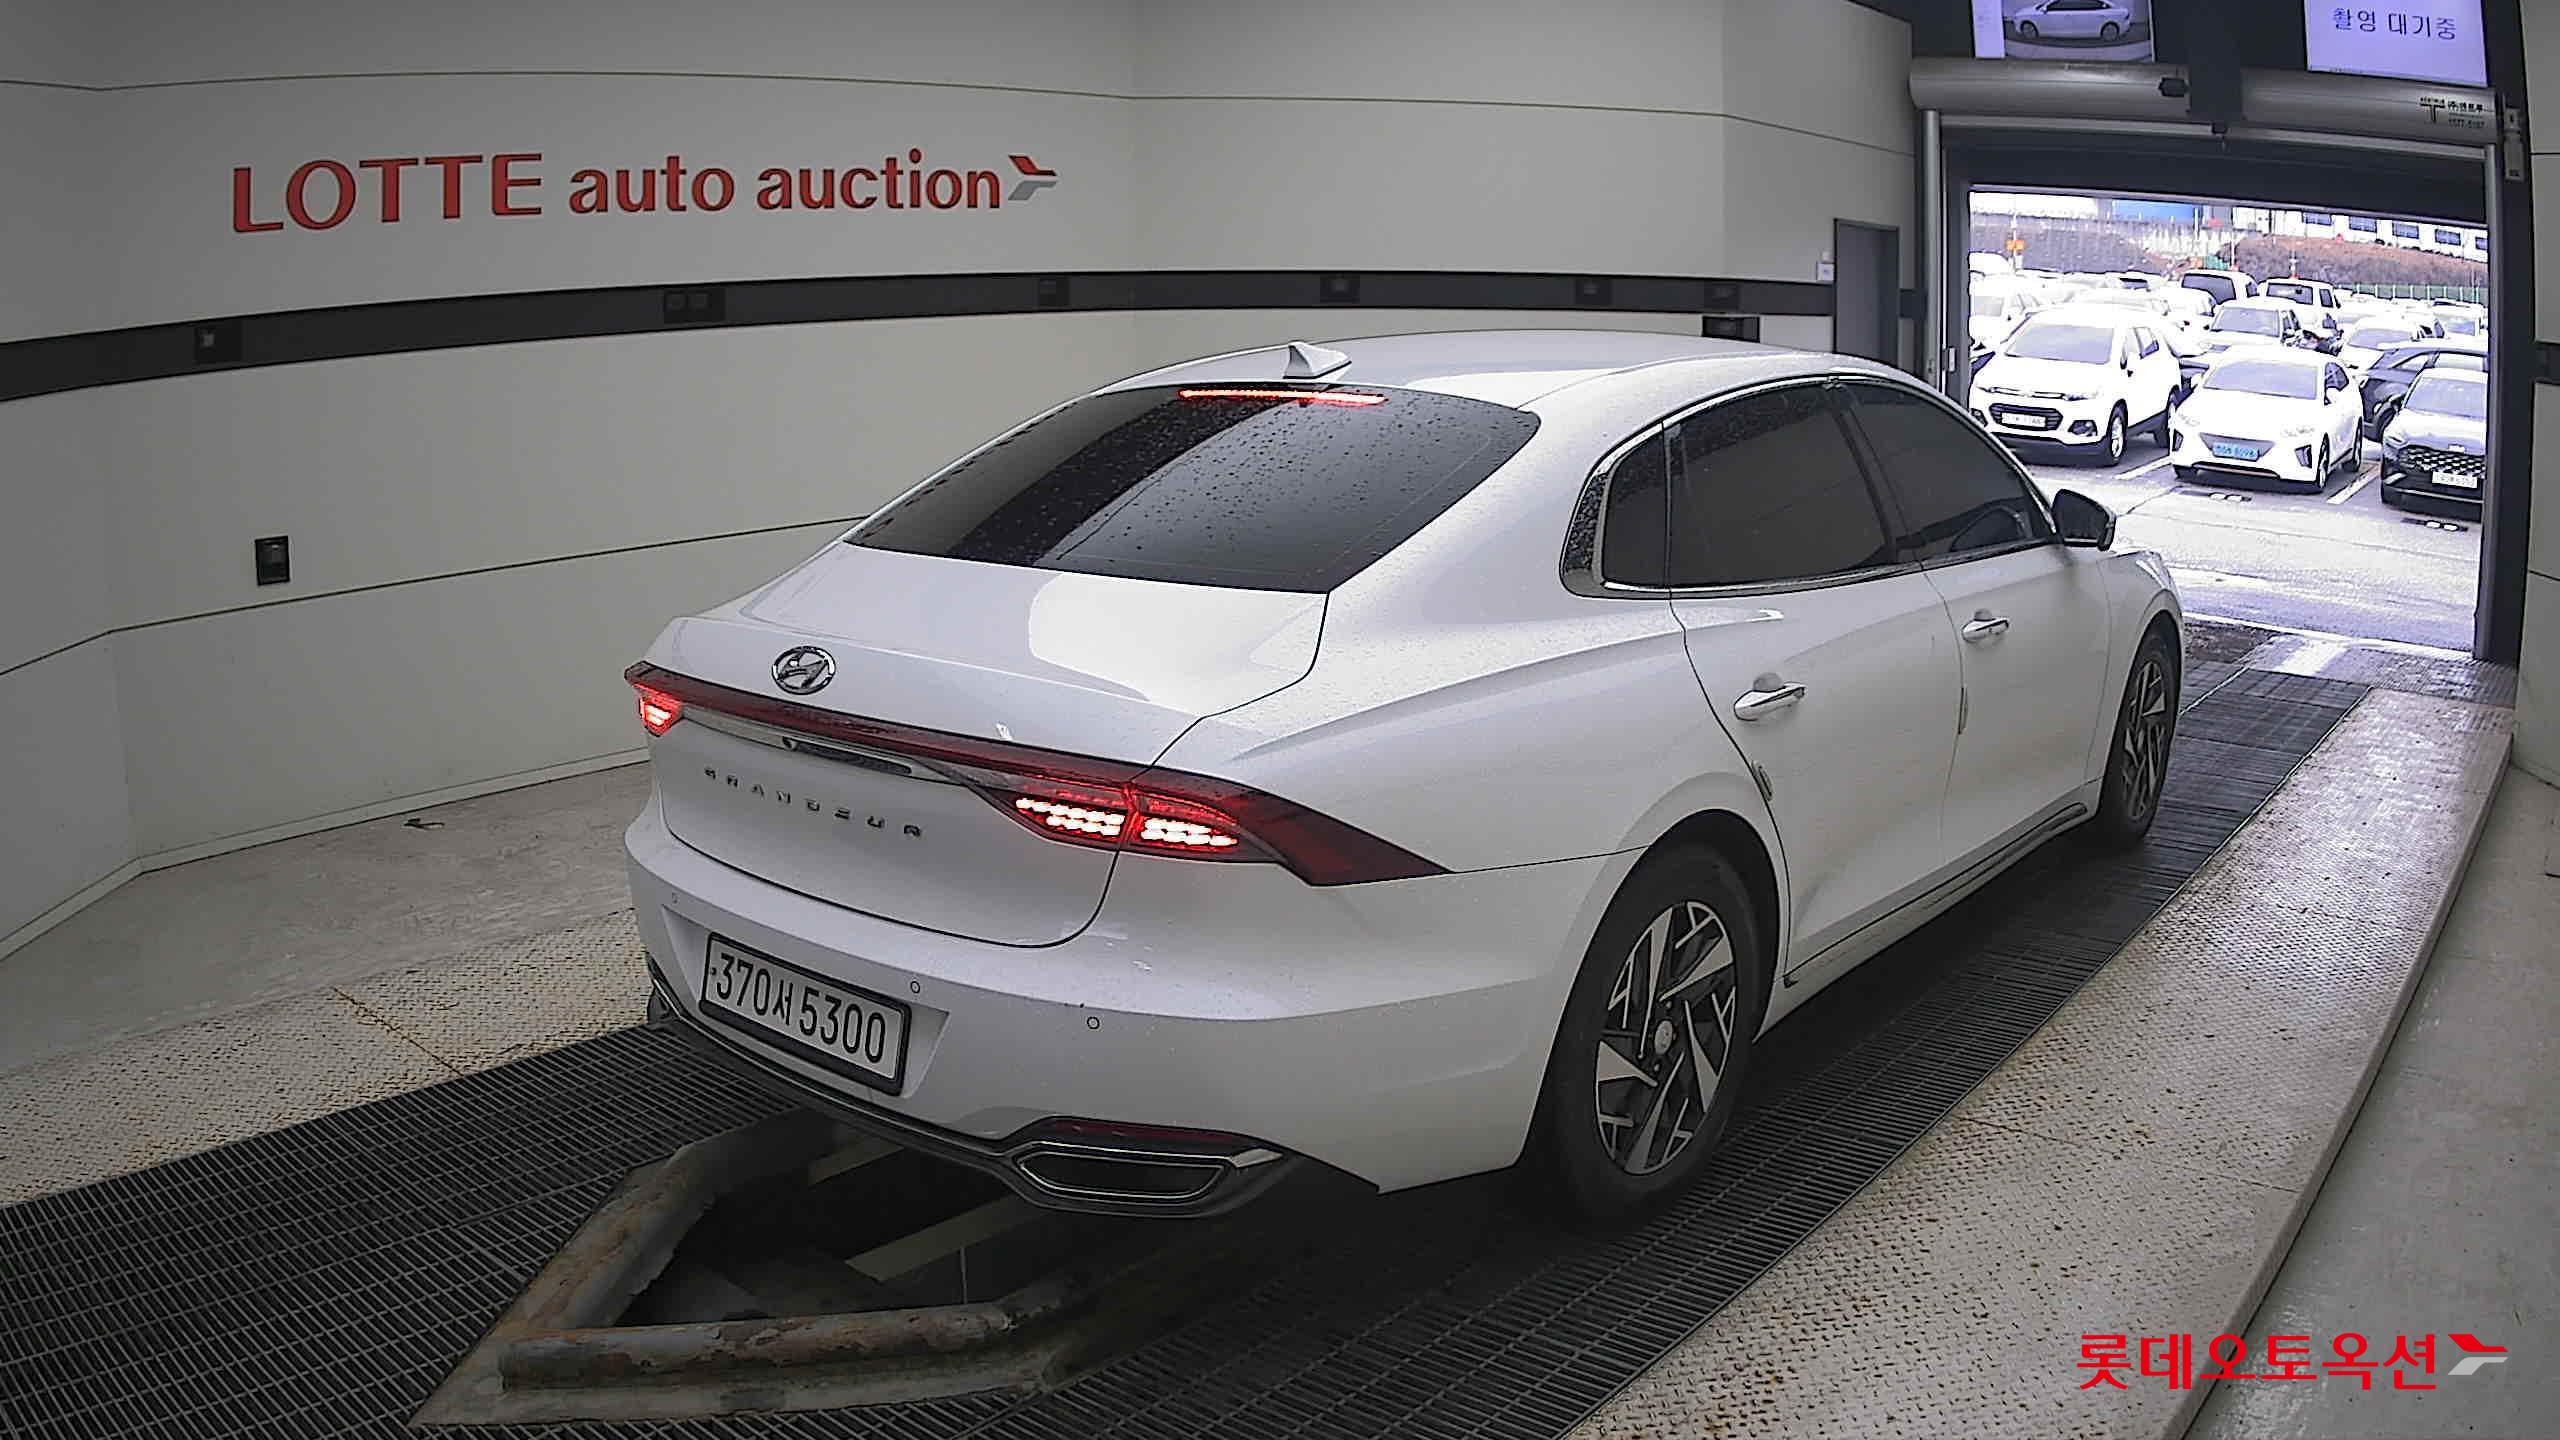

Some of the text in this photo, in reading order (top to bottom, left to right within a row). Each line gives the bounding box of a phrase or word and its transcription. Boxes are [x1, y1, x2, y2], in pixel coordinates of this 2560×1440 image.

[2333, 8, 2457, 40] 촬영 대기중
[232, 148, 1001, 233] LOTTE auto auction
[704, 766, 922, 838] GRANDEUR
